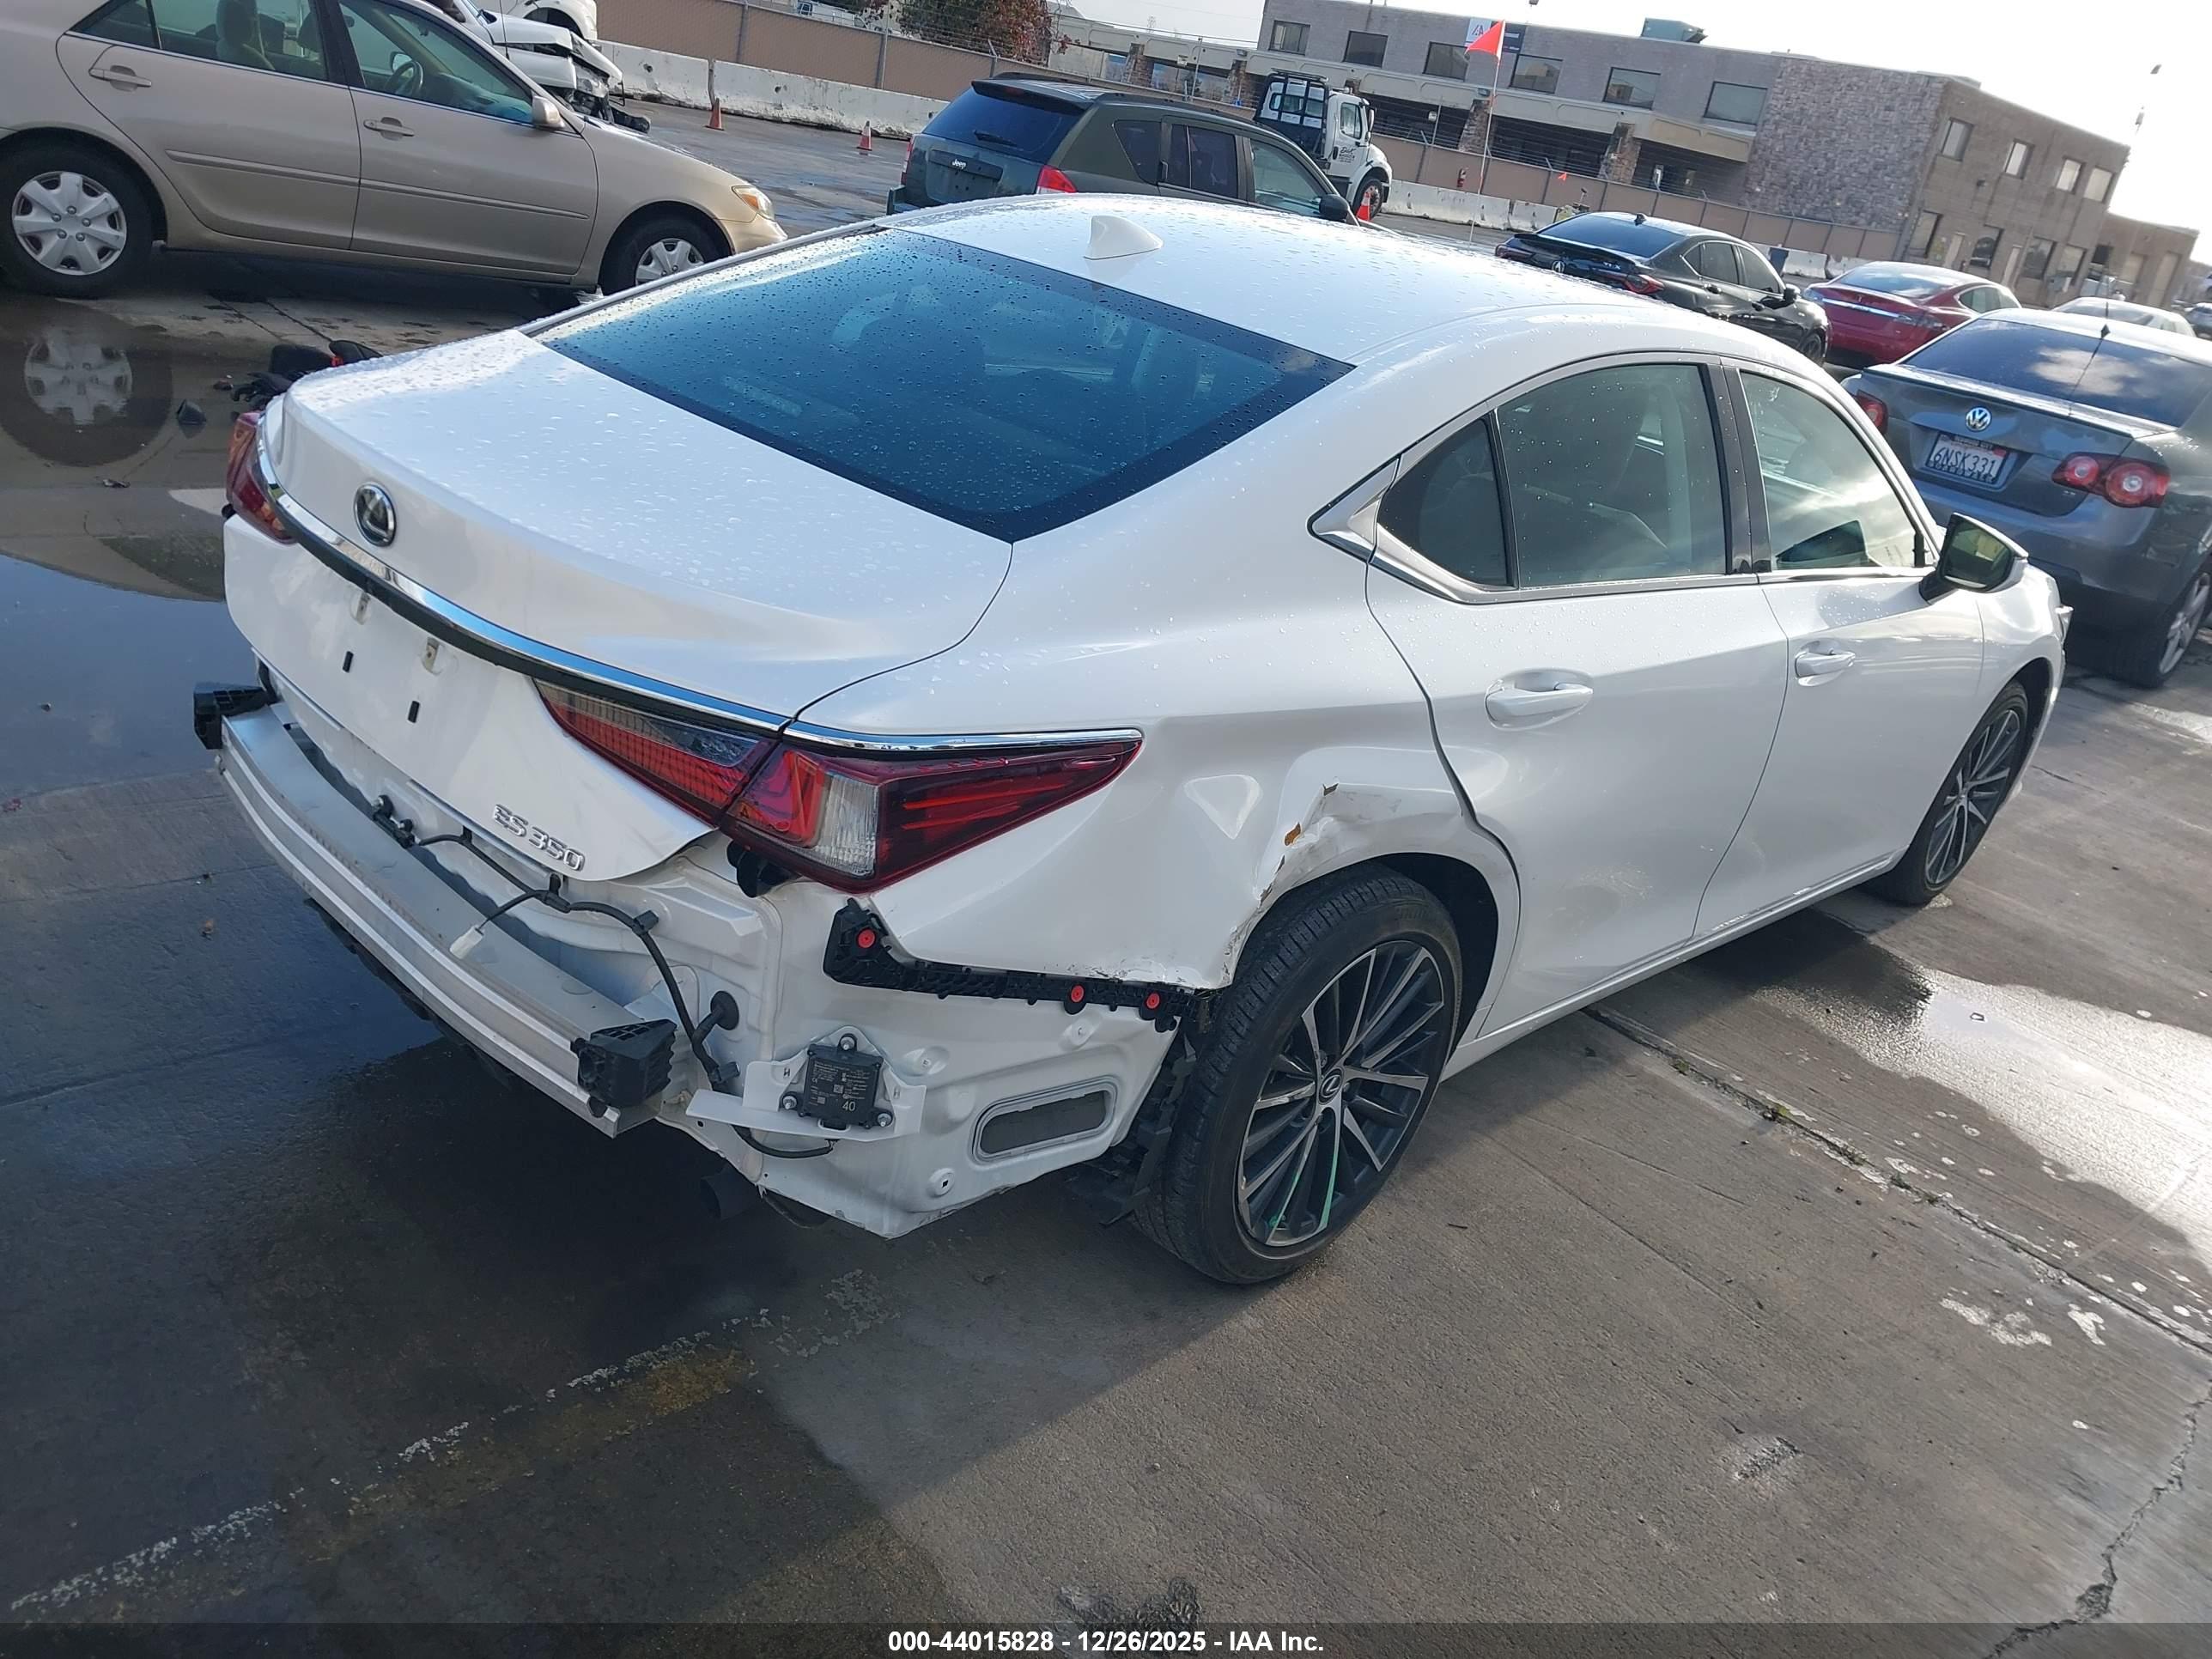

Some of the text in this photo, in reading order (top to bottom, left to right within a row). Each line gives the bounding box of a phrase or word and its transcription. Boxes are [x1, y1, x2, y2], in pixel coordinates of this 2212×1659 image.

[952, 159, 966, 169] Jeep
[1603, 261, 1620, 270] TLX
[1935, 447, 1996, 473] 6NSK331
[493, 803, 586, 872] ES 350
[842, 1100, 856, 1112] 40
